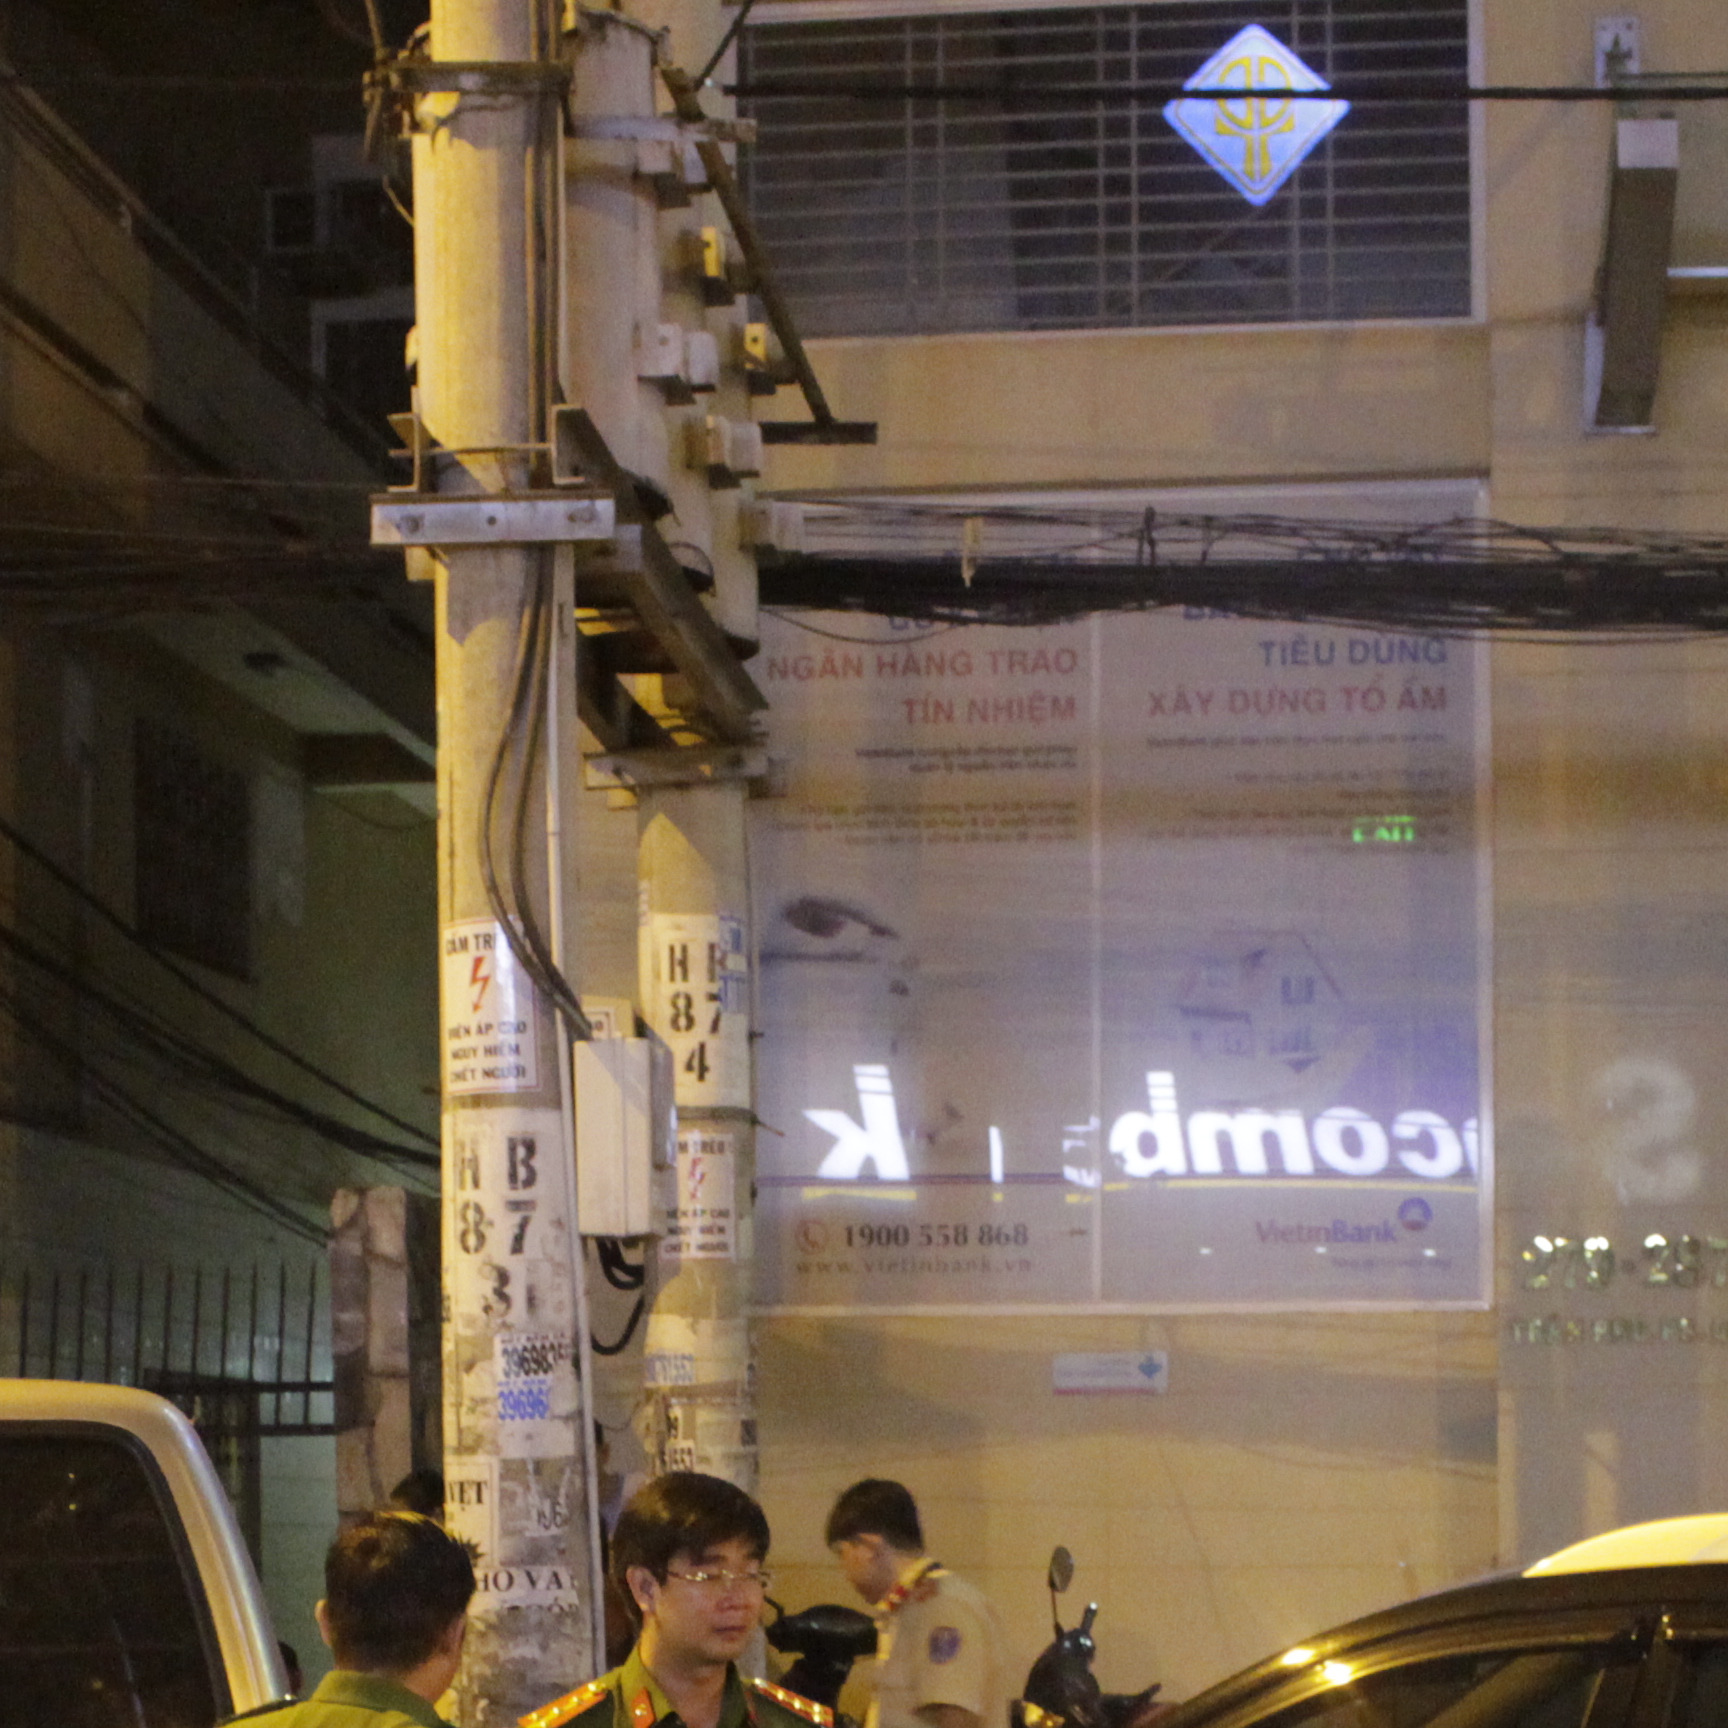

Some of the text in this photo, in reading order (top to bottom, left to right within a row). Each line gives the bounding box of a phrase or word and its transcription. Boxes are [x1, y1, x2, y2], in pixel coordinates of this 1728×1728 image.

[845, 1222, 1029, 1248] 1900 558 868
[1255, 1218, 1398, 1244] VietinBank
